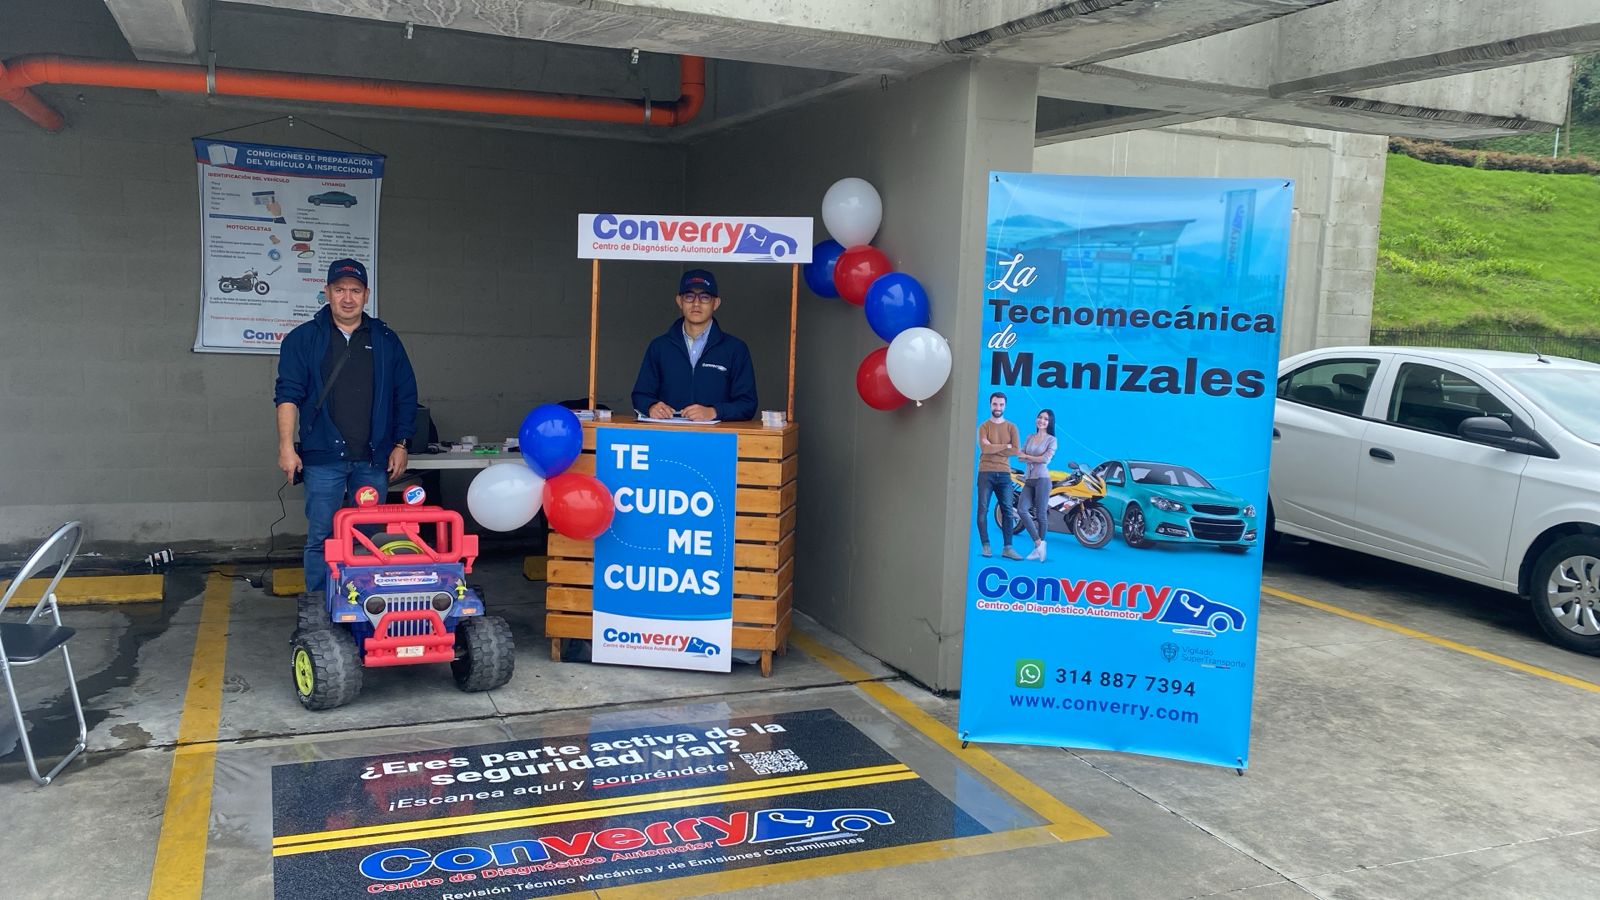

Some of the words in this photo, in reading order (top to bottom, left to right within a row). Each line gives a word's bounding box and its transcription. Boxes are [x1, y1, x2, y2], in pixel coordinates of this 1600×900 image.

[246, 149, 303, 160] CONDICIONES
[304, 154, 315, 162] DE
[317, 156, 373, 166] PREPARACIÓN
[264, 159, 305, 169] VEHÍCULO
[314, 164, 373, 175] INSPECCIONAR
[207, 172, 252, 180] IDENTIFICACIÓN
[226, 224, 272, 232] MOTOCICLETAS
[592, 213, 743, 253] Converry
[592, 242, 619, 251] Centro
[620, 243, 631, 251] de
[632, 243, 679, 254] Diagnóstico
[680, 245, 723, 254] Automotor
[988, 253, 1038, 293] La
[988, 299, 1276, 334] Tecnomecánica
[243, 329, 289, 340] Conv
[988, 324, 1018, 350] de
[989, 351, 1266, 399] Manizales
[611, 444, 649, 471] TE
[614, 486, 714, 517] CUIDO
[667, 528, 712, 556] ME
[603, 564, 721, 596] CUIDAS
[977, 566, 1171, 620] Converry
[976, 599, 1010, 611] Centro
[1012, 602, 1024, 612] de
[1026, 603, 1085, 616] Diagnóstico
[1086, 607, 1140, 620] Automotor
[603, 628, 690, 652] Converry
[1182, 653, 1246, 668] SuperTransporte
[1055, 668, 1092, 686] 314
[1100, 671, 1137, 689] 887
[1145, 676, 1196, 697] 7394
[1009, 693, 1199, 724] www.converry.com
[360, 754, 470, 781] ¿Eres
[481, 743, 581, 769] parte
[590, 732, 698, 752] activa
[705, 726, 746, 740] de
[751, 722, 787, 735] la
[430, 750, 642, 787] seguridad
[652, 740, 741, 762] víal?
[389, 789, 504, 812] ¡Escanea
[513, 780, 565, 799] aquí
[566, 780, 585, 790] y
[592, 761, 735, 787] sorpréndete!
[358, 811, 749, 881] Converry
[367, 877, 444, 894] Centro
[448, 873, 477, 883] de
[481, 854, 607, 879] Diagnóstico
[611, 840, 714, 862] Automotor
[443, 886, 511, 900] Revisión
[513, 876, 576, 892] Técnico
[579, 866, 652, 883] Mecánica
[655, 864, 665, 874] y
[668, 861, 686, 870] de
[690, 851, 761, 868] Emisiones
[763, 836, 865, 857] Contaminantes
